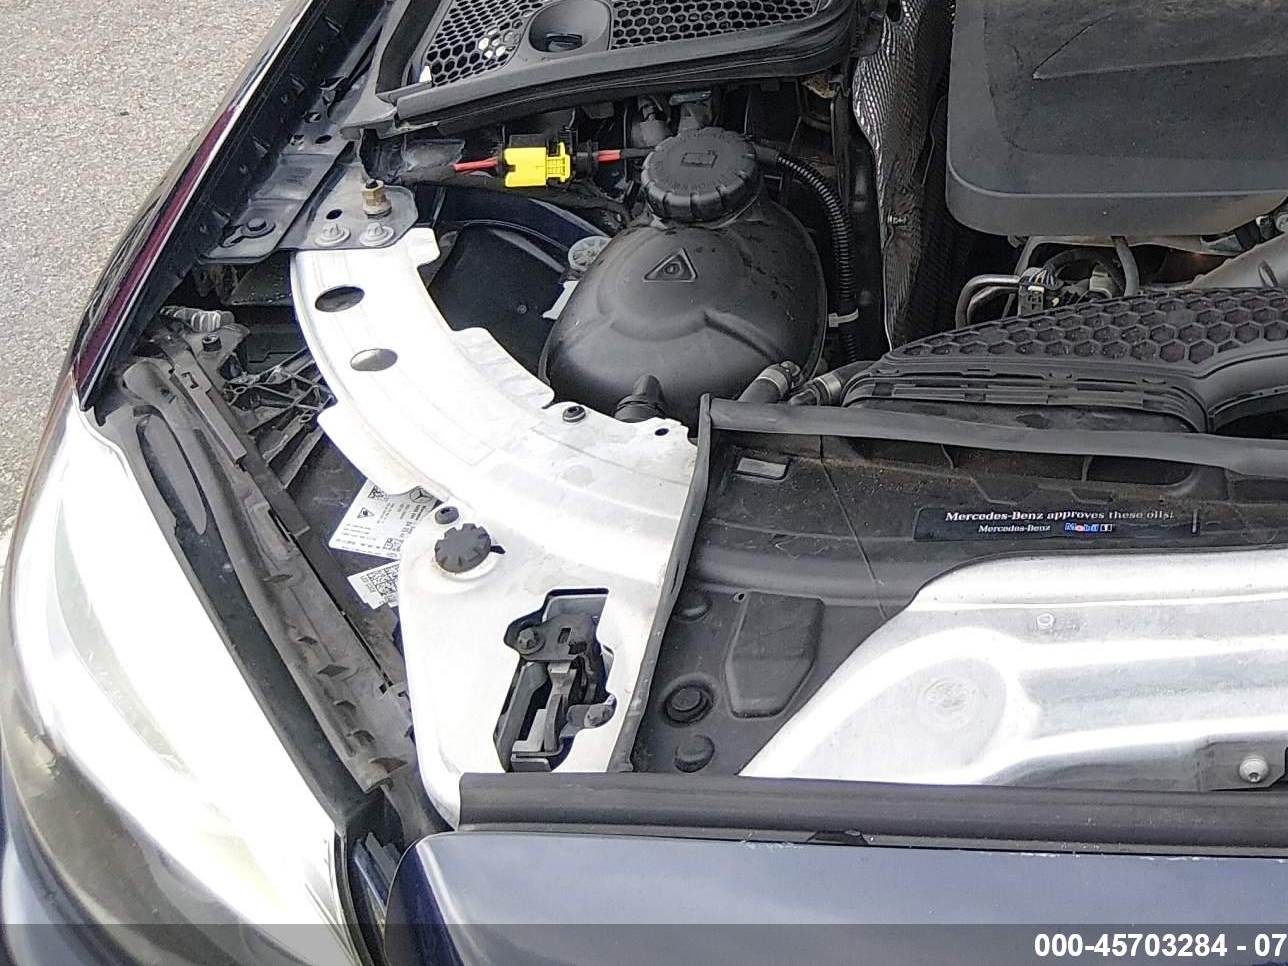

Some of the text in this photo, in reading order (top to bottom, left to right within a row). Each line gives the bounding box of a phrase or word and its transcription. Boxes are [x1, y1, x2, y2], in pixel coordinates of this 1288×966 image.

[944, 511, 1045, 522] Mercedes-Benz
[1046, 510, 1105, 521] approves
[1108, 510, 1144, 520] these
[977, 524, 1051, 533] Mercedes-Benz
[1064, 522, 1099, 532] Mobil
